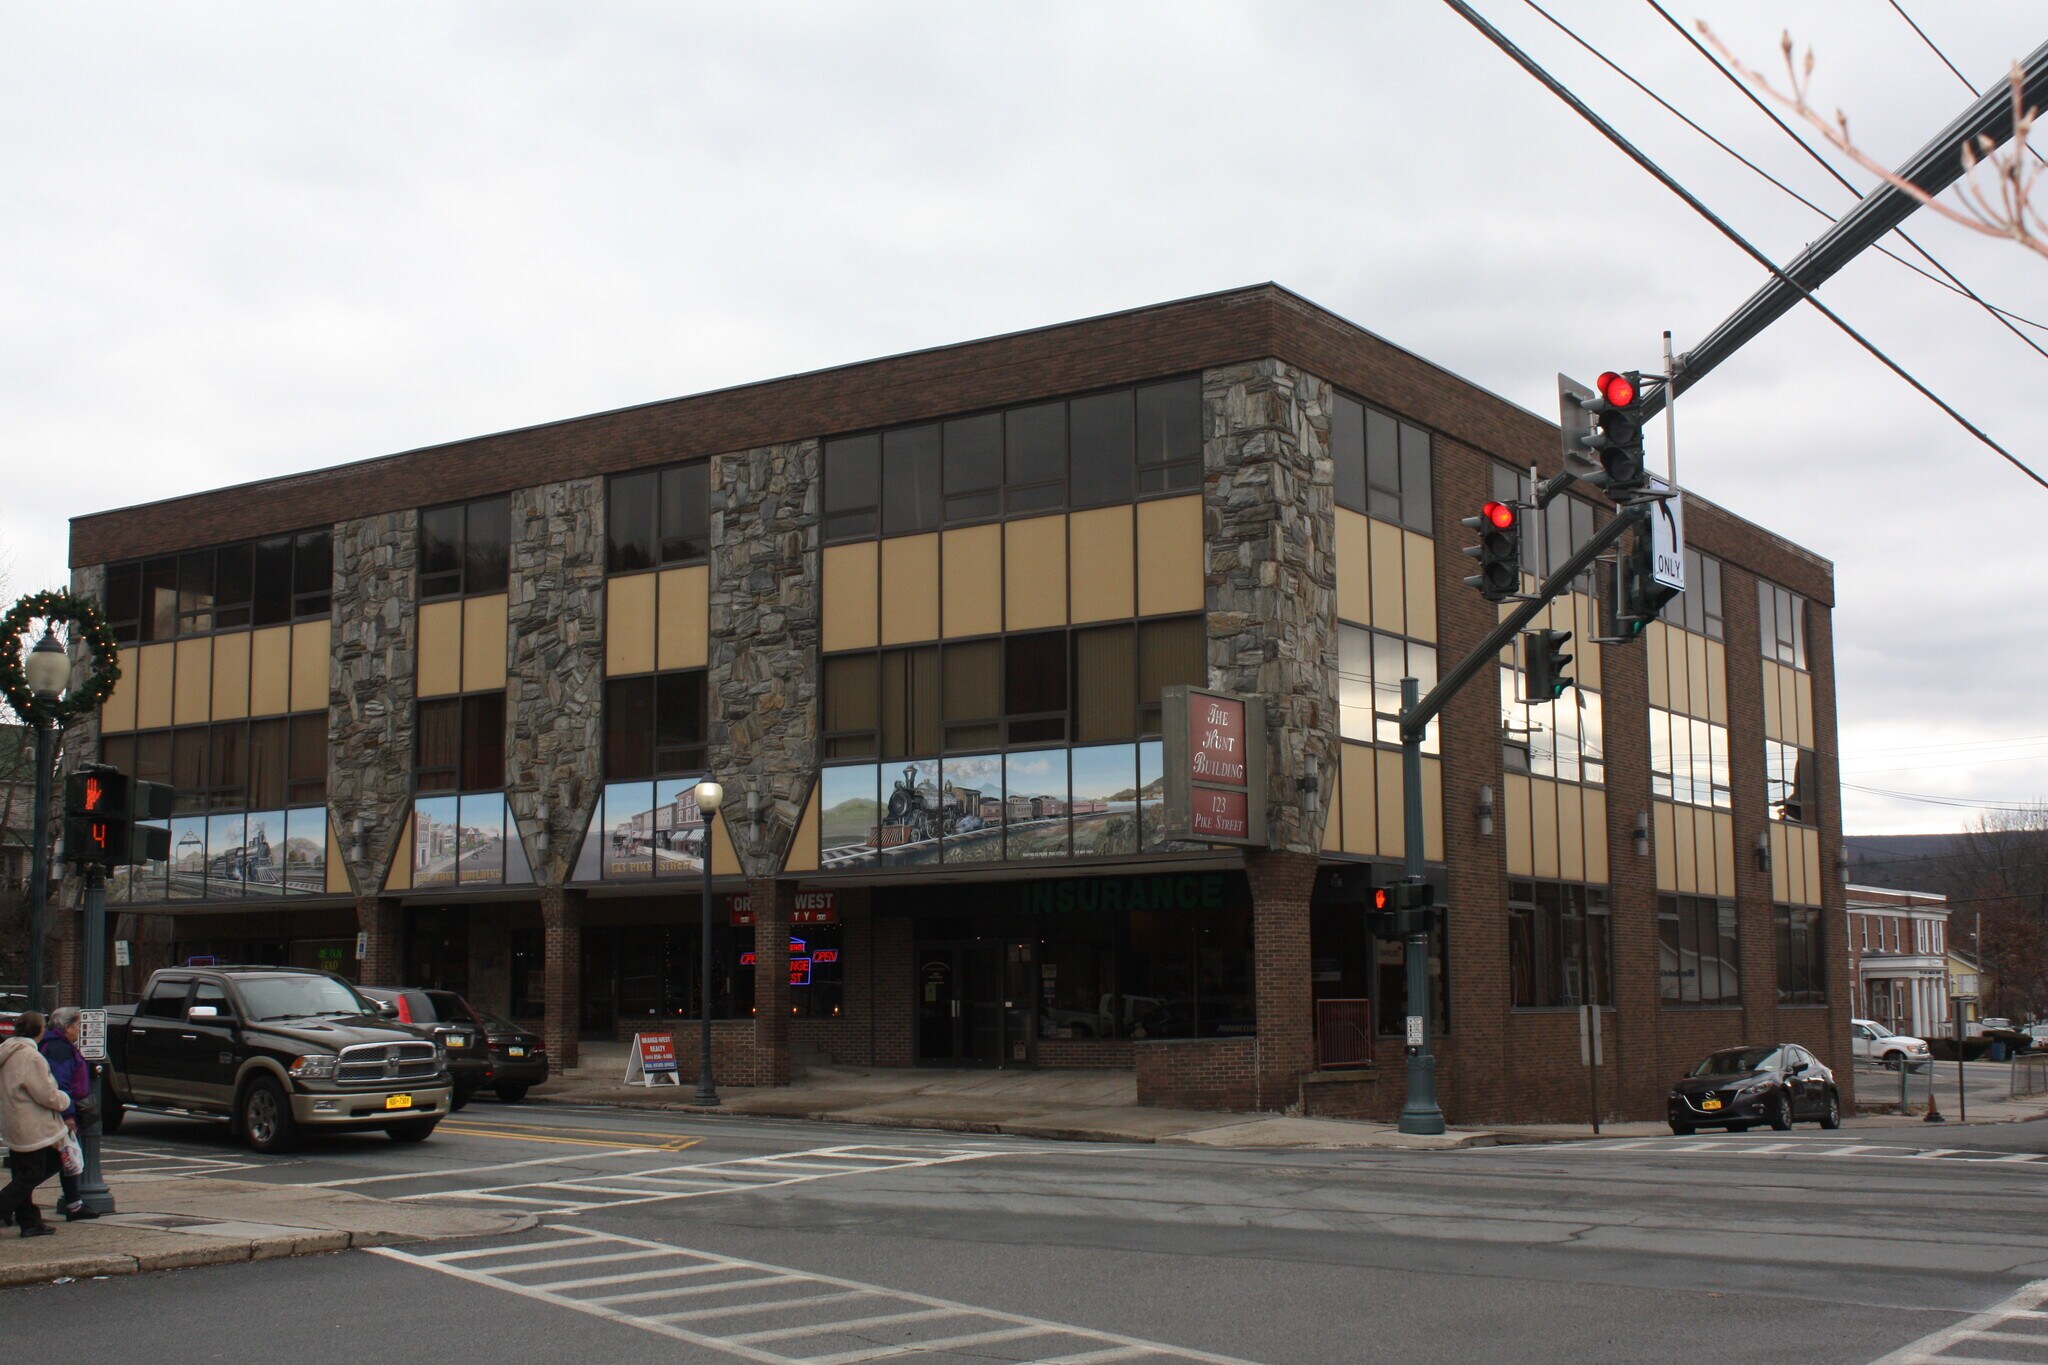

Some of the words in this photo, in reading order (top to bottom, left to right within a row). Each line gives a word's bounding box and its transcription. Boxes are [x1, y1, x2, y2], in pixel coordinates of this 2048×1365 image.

[1658, 554, 1680, 578] ONLY
[1208, 704, 1228, 725] THE
[1203, 729, 1235, 751] HUNT
[1193, 752, 1243, 779] BUILDING
[1212, 796, 1226, 813] 123
[1195, 813, 1212, 829] PIKE
[1216, 817, 1243, 832] STREET
[92, 824, 106, 849] 4
[461, 869, 501, 880] BUILDING
[629, 862, 652, 872] PIKE
[659, 860, 692, 870] STREET
[795, 893, 833, 909] WEST
[1023, 875, 1224, 913] INSURANCE
[814, 951, 837, 961] OPEN
